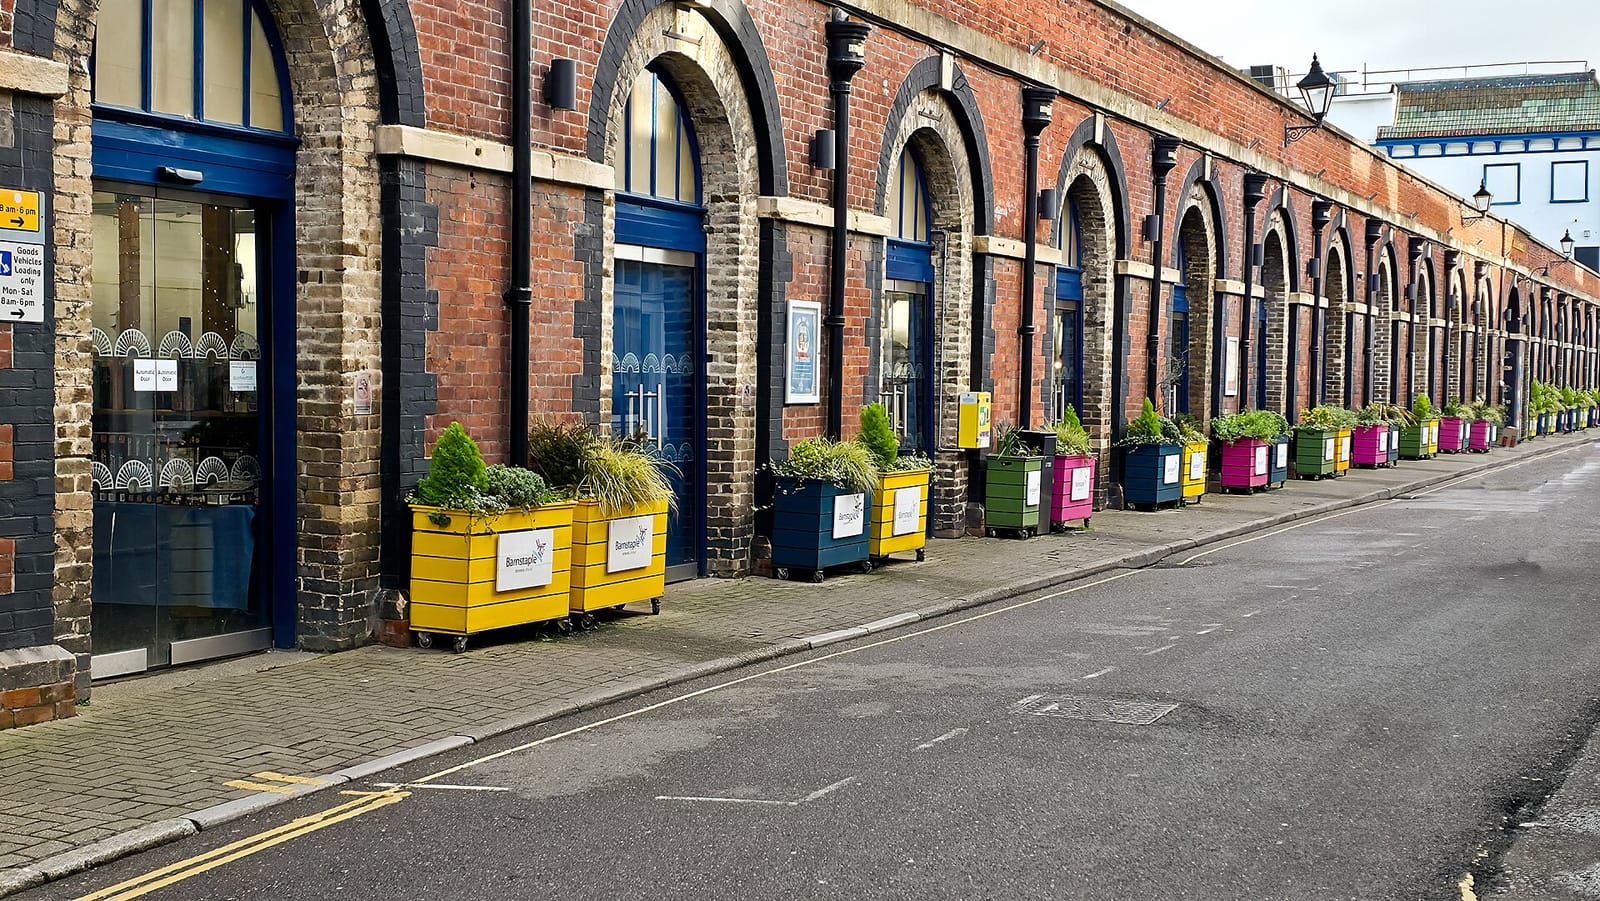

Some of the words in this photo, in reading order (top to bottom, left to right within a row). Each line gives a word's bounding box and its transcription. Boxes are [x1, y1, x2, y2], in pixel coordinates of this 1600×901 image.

[16, 246, 39, 255] Goods
[13, 255, 42, 265] Vehicles
[14, 265, 41, 276] Loading
[20, 277, 35, 285] only
[505, 554, 537, 568] Barnstaple
